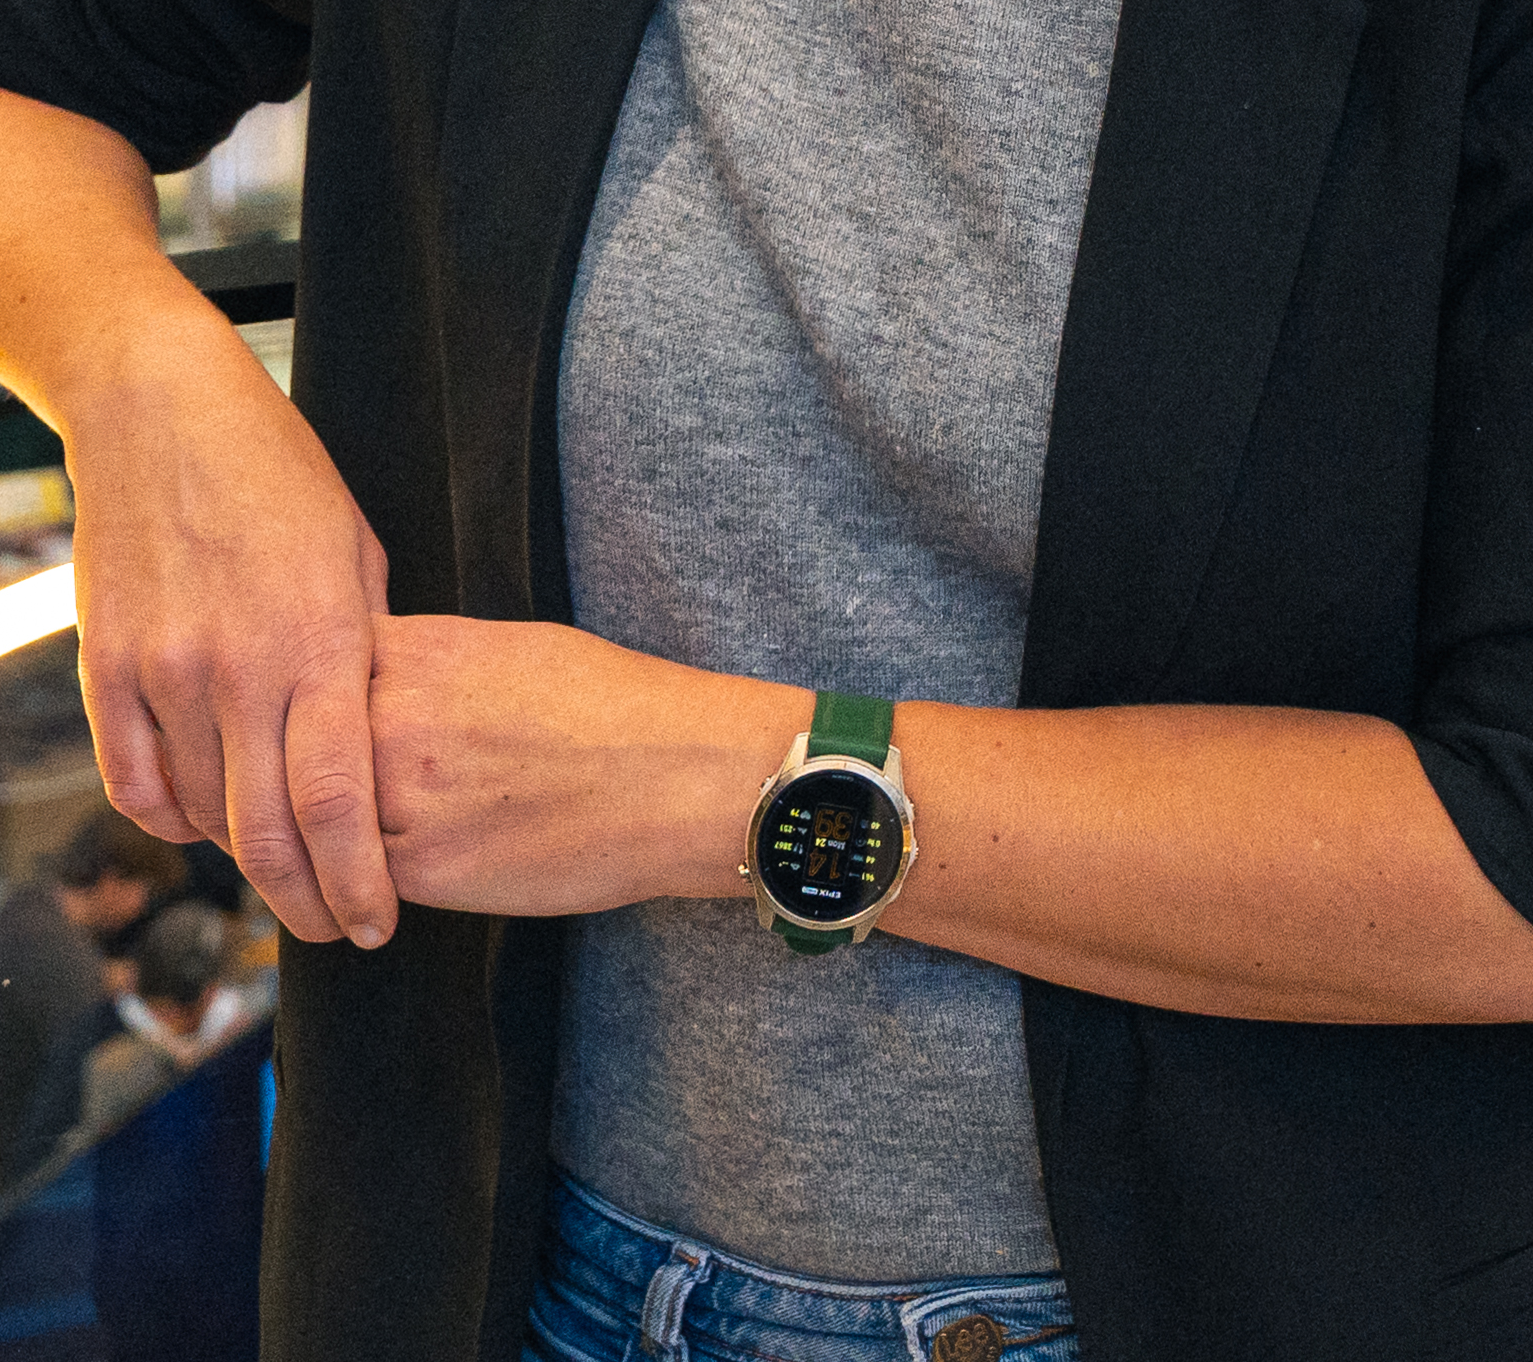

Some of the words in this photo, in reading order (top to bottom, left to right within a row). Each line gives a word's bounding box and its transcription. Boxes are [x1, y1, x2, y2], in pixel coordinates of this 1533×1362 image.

[815, 809, 853, 841] 39
[815, 837, 827, 846] 24
[808, 848, 841, 880] 14
[819, 889, 841, 899] EPIX
